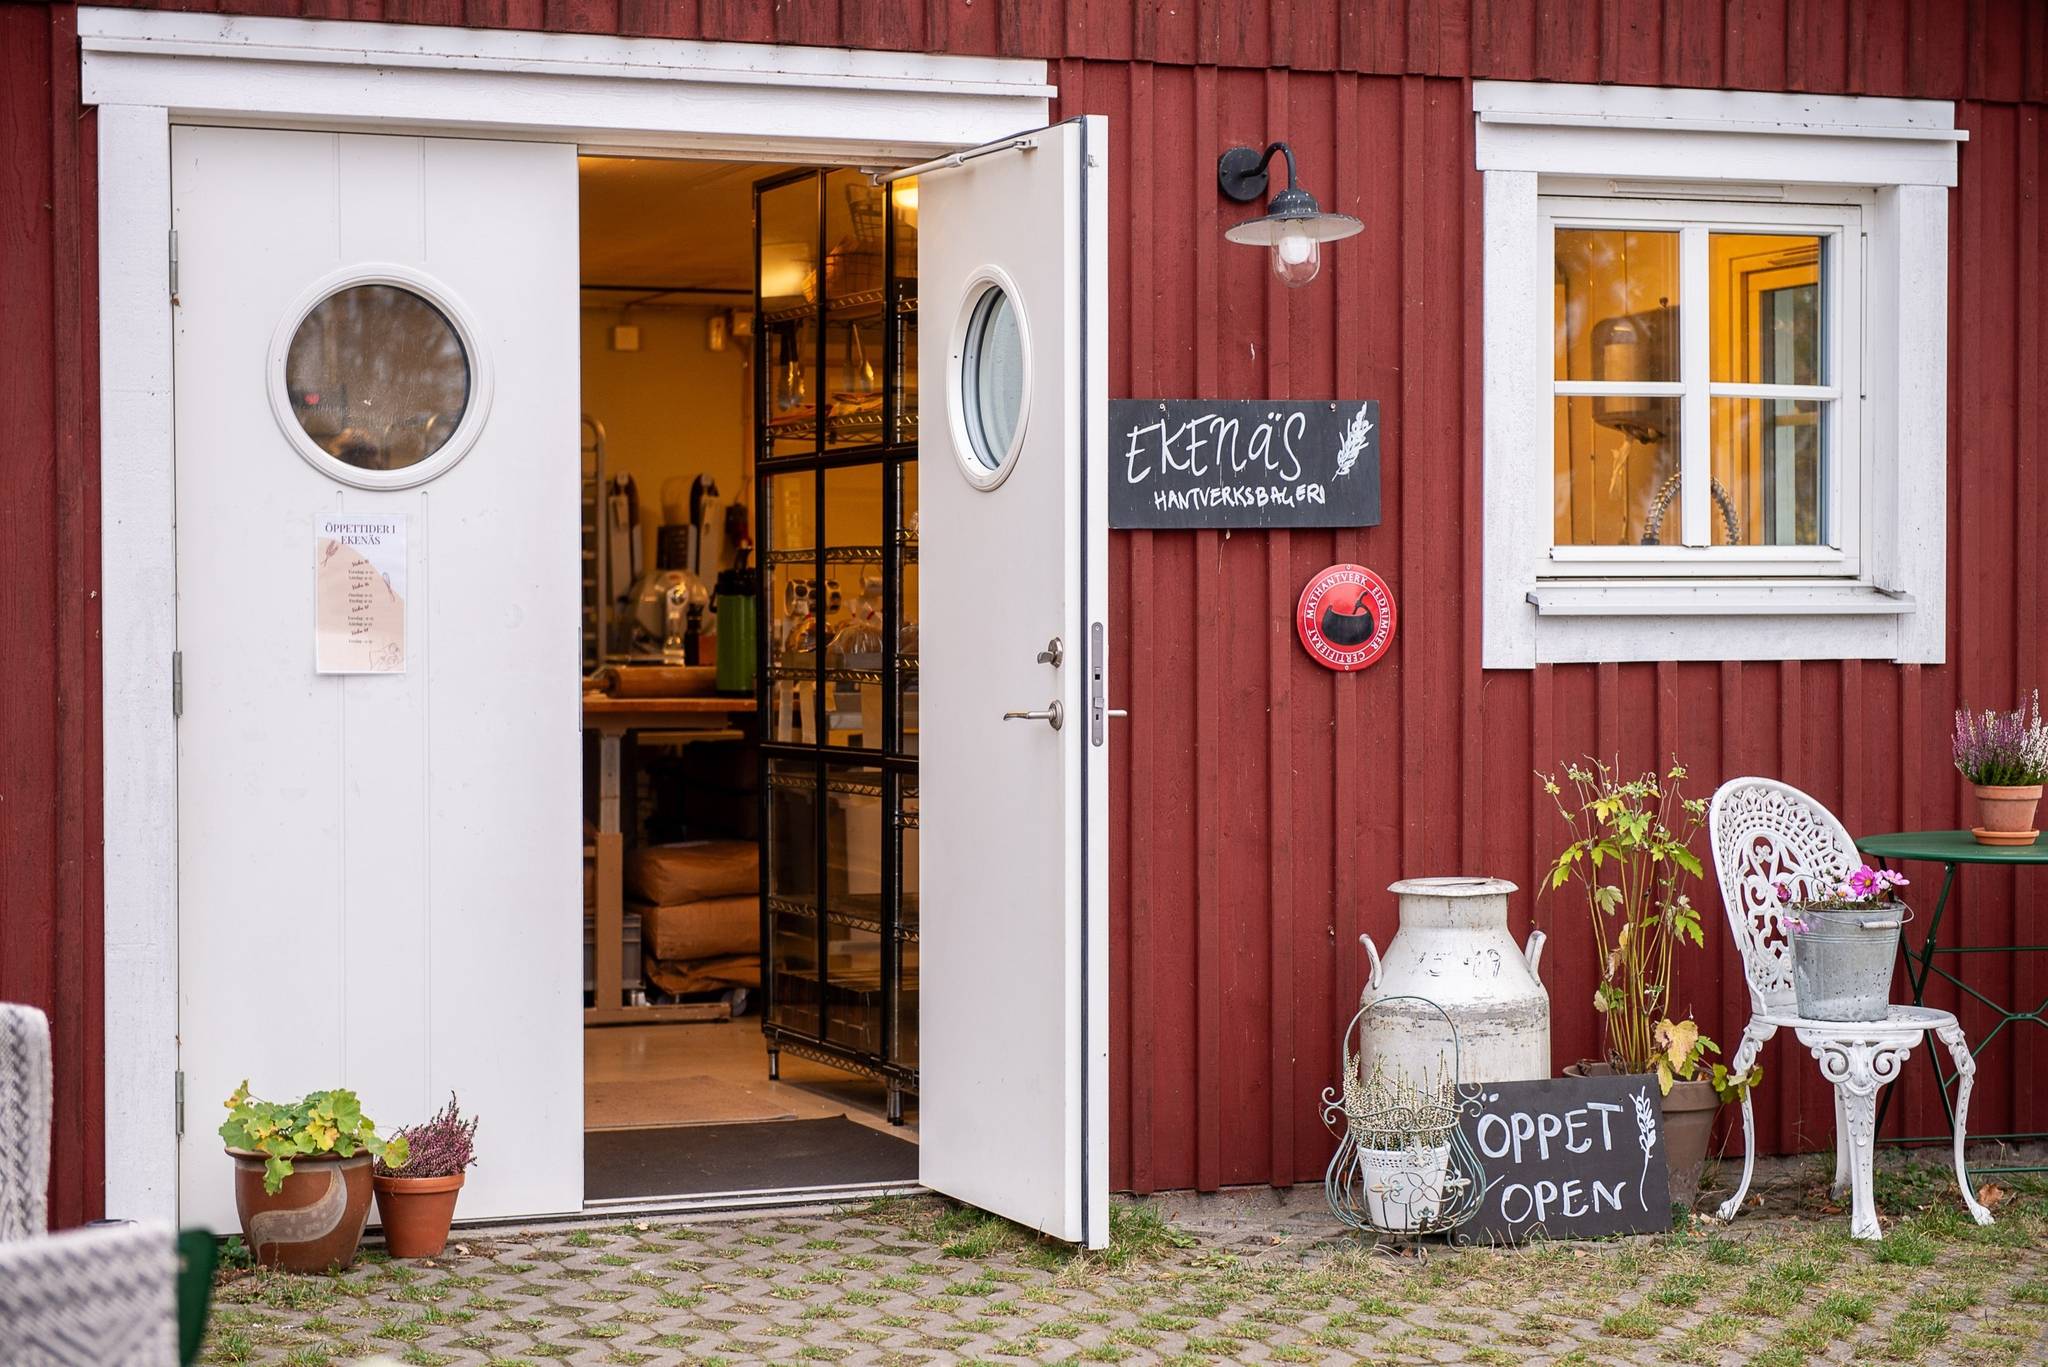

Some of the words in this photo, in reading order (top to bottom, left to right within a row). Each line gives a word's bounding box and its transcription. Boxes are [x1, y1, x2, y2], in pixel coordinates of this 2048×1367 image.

[1154, 483, 1325, 511] HANTVERKSBAGERI
[325, 522, 390, 534] ÖPPETTIDER
[341, 534, 381, 544] EKENÄS
[1305, 572, 1368, 619] MATHANTVERK
[1370, 585, 1390, 650] ELDRIMNER
[1308, 629, 1367, 662] CERTIFIERAT
[1477, 1092, 1624, 1164] ÖPPET
[1501, 1179, 1627, 1224] OPEN
